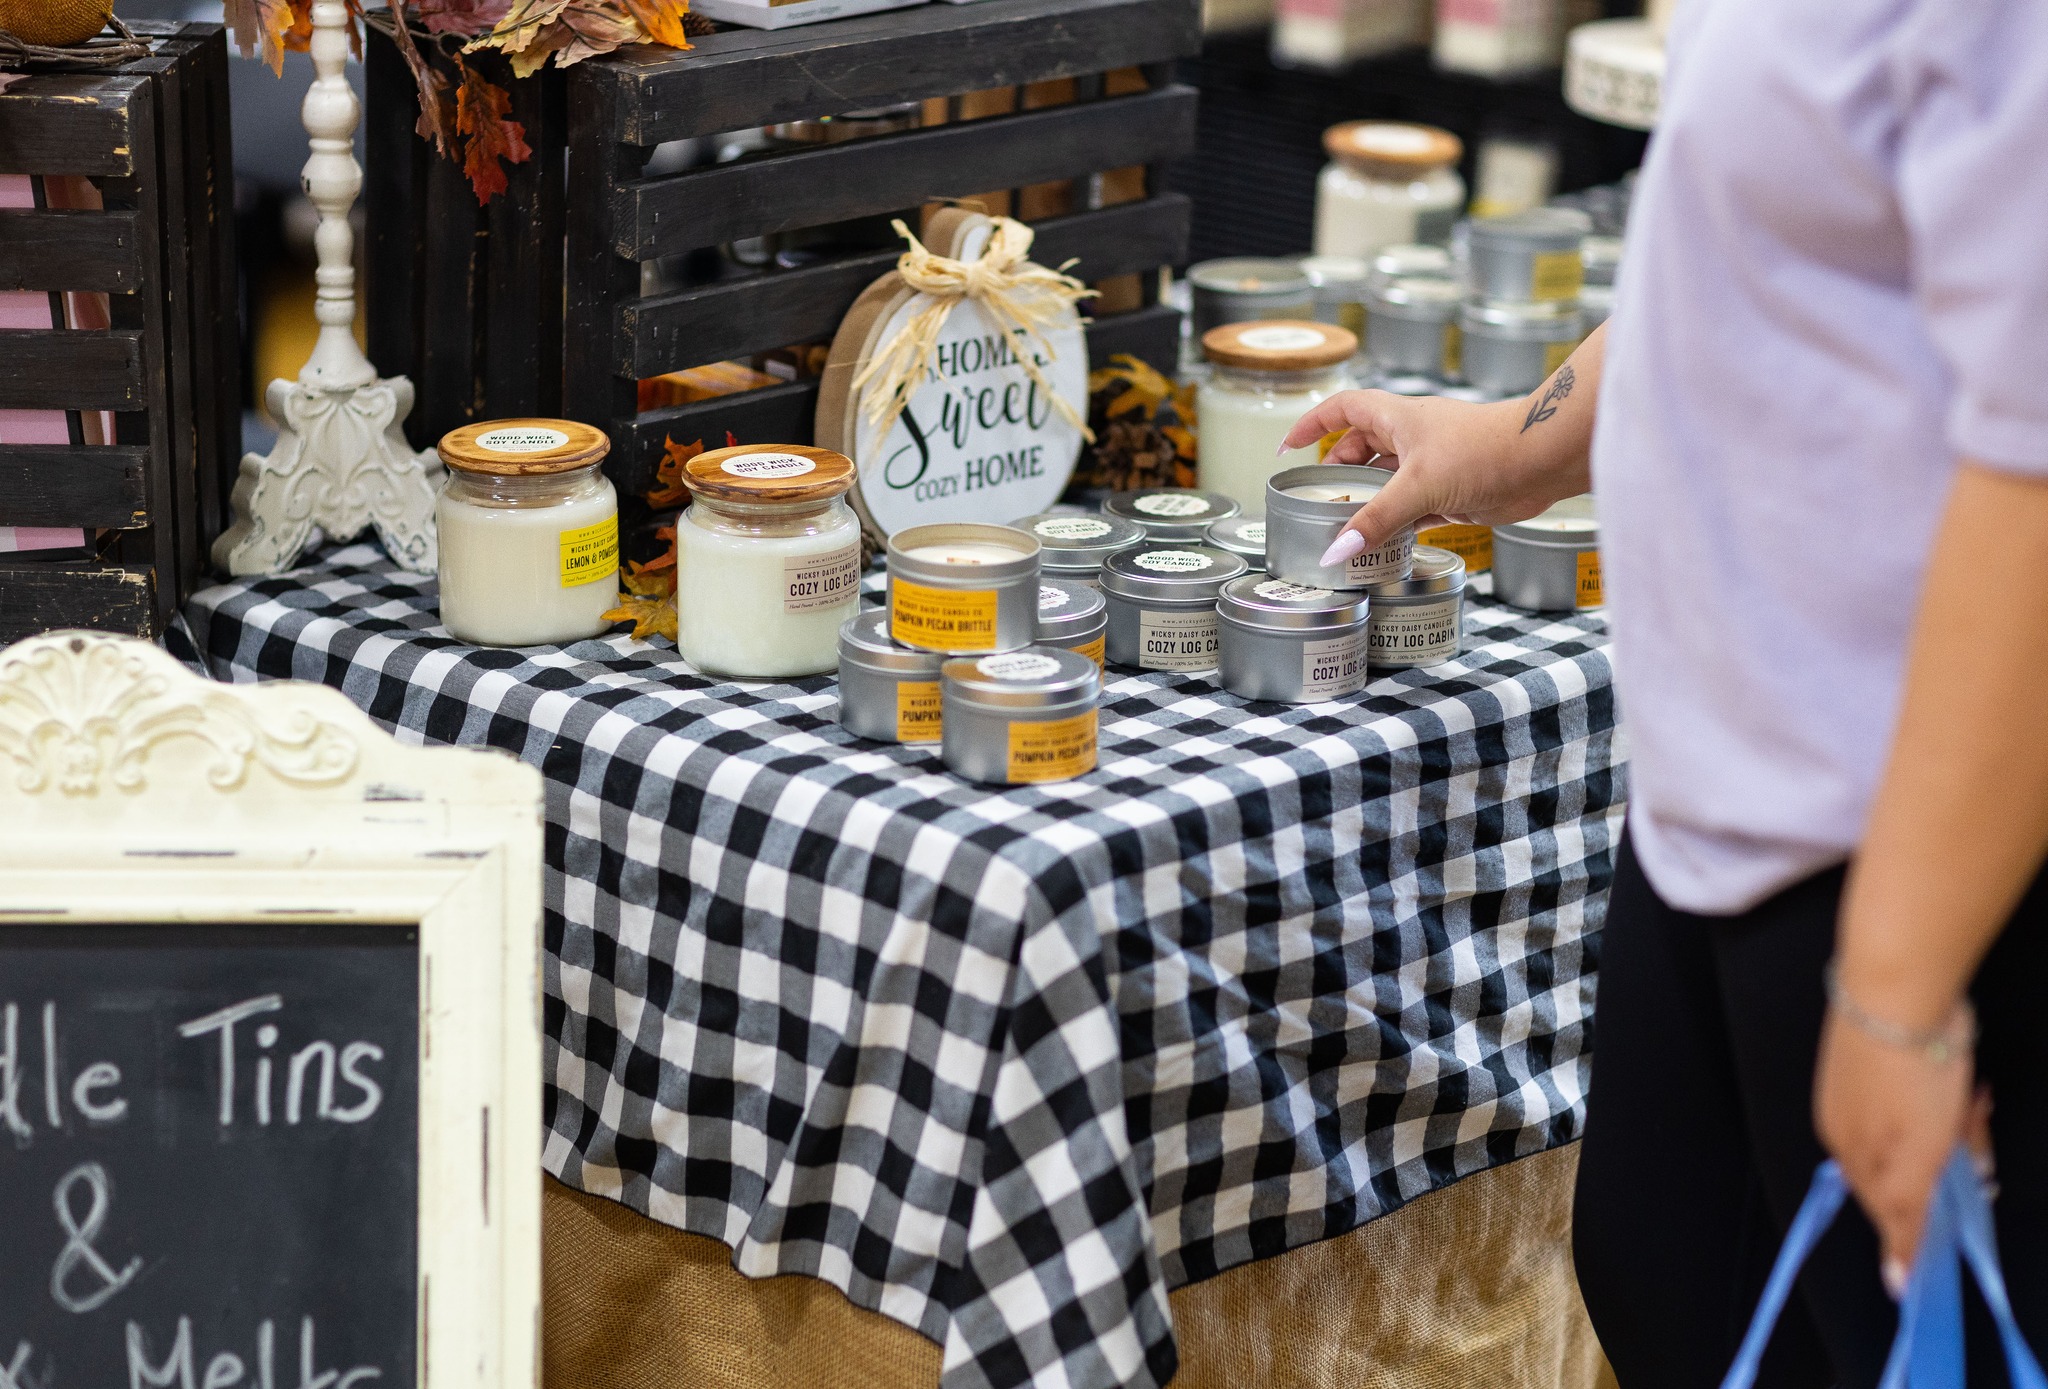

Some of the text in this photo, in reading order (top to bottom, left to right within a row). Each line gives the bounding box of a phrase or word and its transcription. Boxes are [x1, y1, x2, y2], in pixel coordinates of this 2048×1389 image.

[734, 461, 765, 469] WOOD
[767, 457, 796, 465] WICK
[762, 462, 806, 470] CANDLE
[915, 445, 1044, 503] COZY HOME
[571, 544, 592, 554] WICKSY
[1352, 552, 1381, 568] COZY
[1385, 548, 1401, 564] LOG
[566, 554, 590, 570] LEMON
[796, 571, 820, 580] WICKSY
[821, 567, 838, 577] DAISY
[839, 560, 854, 572] CANDLE
[790, 581, 819, 597] COZY
[824, 576, 841, 592] LOG
[894, 608, 993, 632] PUMPKIN PECAN BRITTLE
[1373, 624, 1399, 633] WICKSY
[1401, 624, 1422, 633] DAISY
[1423, 620, 1445, 631] CANDLE
[1151, 628, 1218, 639] WICKSY DAISY CAND
[1370, 627, 1455, 648] COZY LOG CABIN
[1147, 639, 1176, 654] COZY
[1181, 641, 1202, 654] LOG
[1317, 656, 1340, 665] WICKSY
[1341, 651, 1356, 661] DAISY
[1313, 665, 1340, 681] COZY
[1343, 660, 1358, 677] LOG
[902, 710, 942, 722] PUMPKIN
[178, 994, 385, 1126] Tins
[50, 1162, 144, 1314] &
